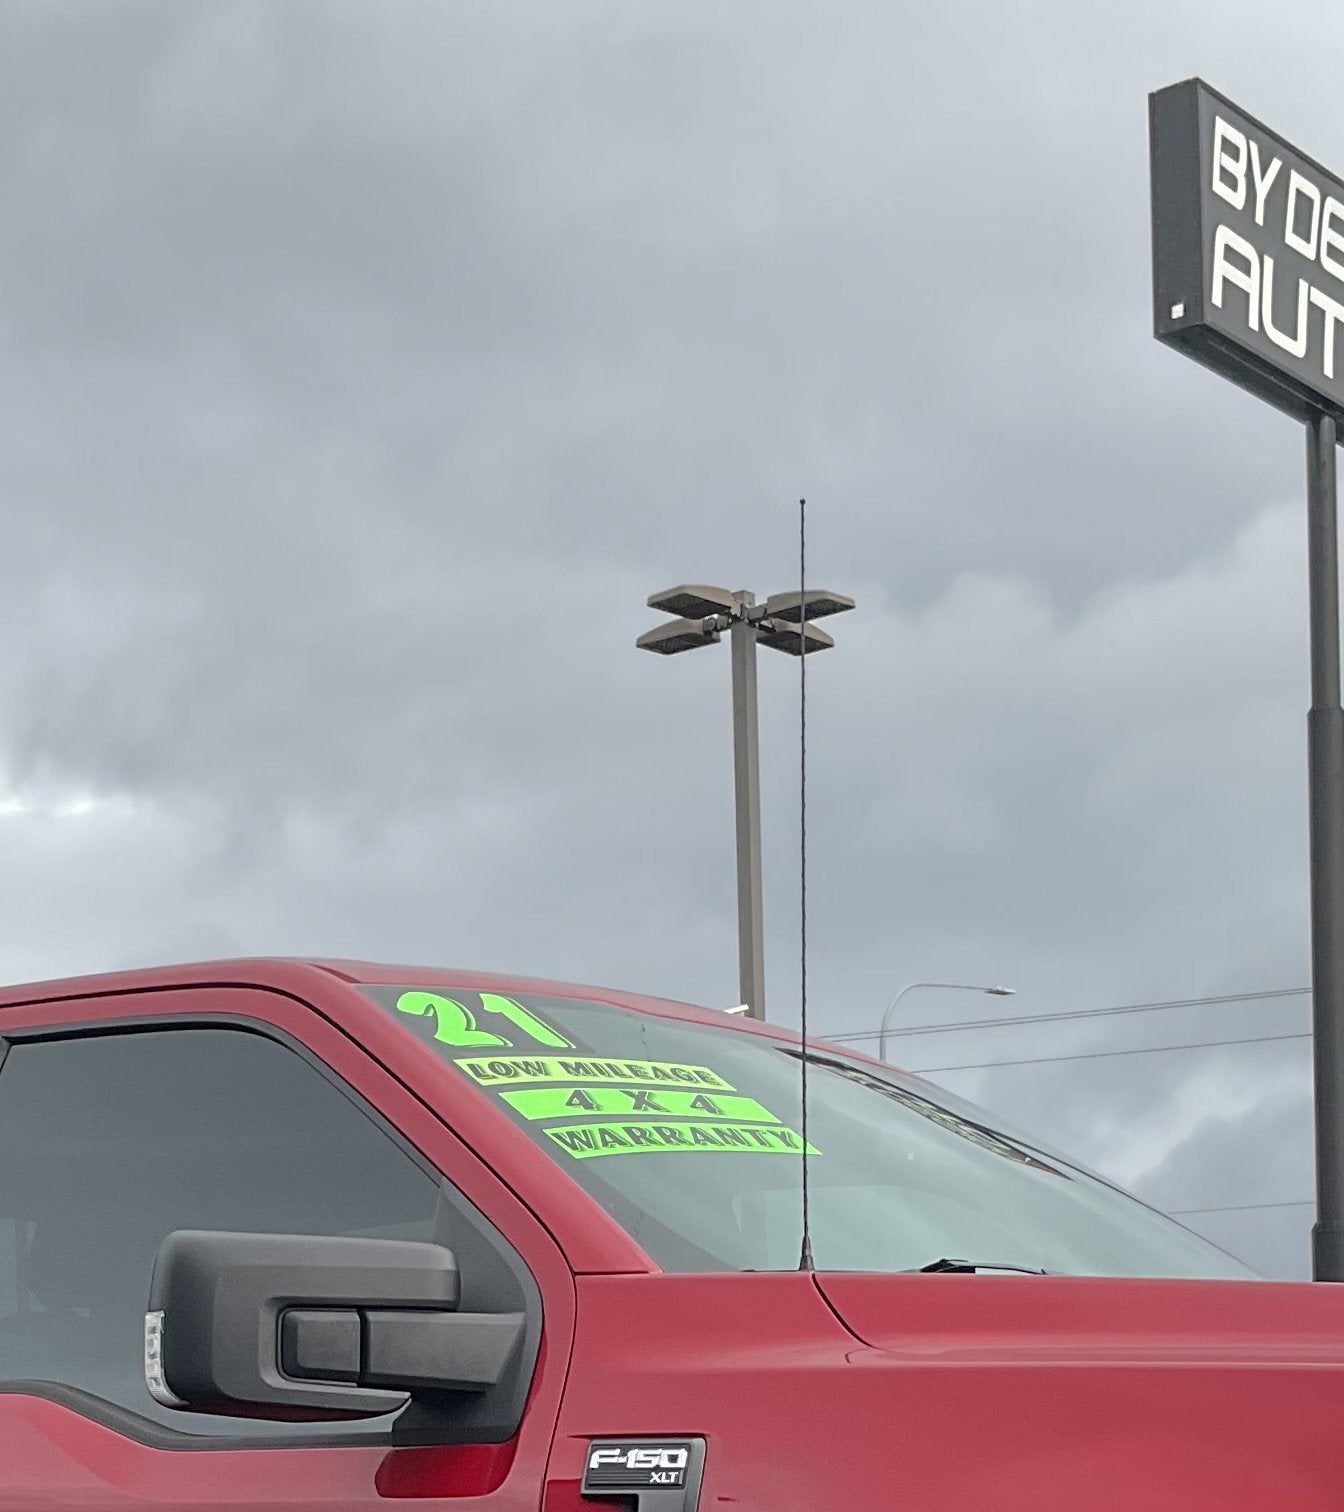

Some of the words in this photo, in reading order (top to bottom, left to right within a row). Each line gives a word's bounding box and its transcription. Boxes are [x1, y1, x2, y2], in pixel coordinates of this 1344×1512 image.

[1211, 115, 1283, 227] BY
[396, 991, 577, 1049] 21
[466, 1061, 550, 1080] LOW
[558, 1060, 723, 1087] MILEAGE
[564, 1088, 603, 1112] 4
[689, 1093, 723, 1116] 4
[555, 1126, 803, 1153] WARRANTY
[589, 1448, 689, 1469] F-150
[649, 1471, 679, 1484] XLT
